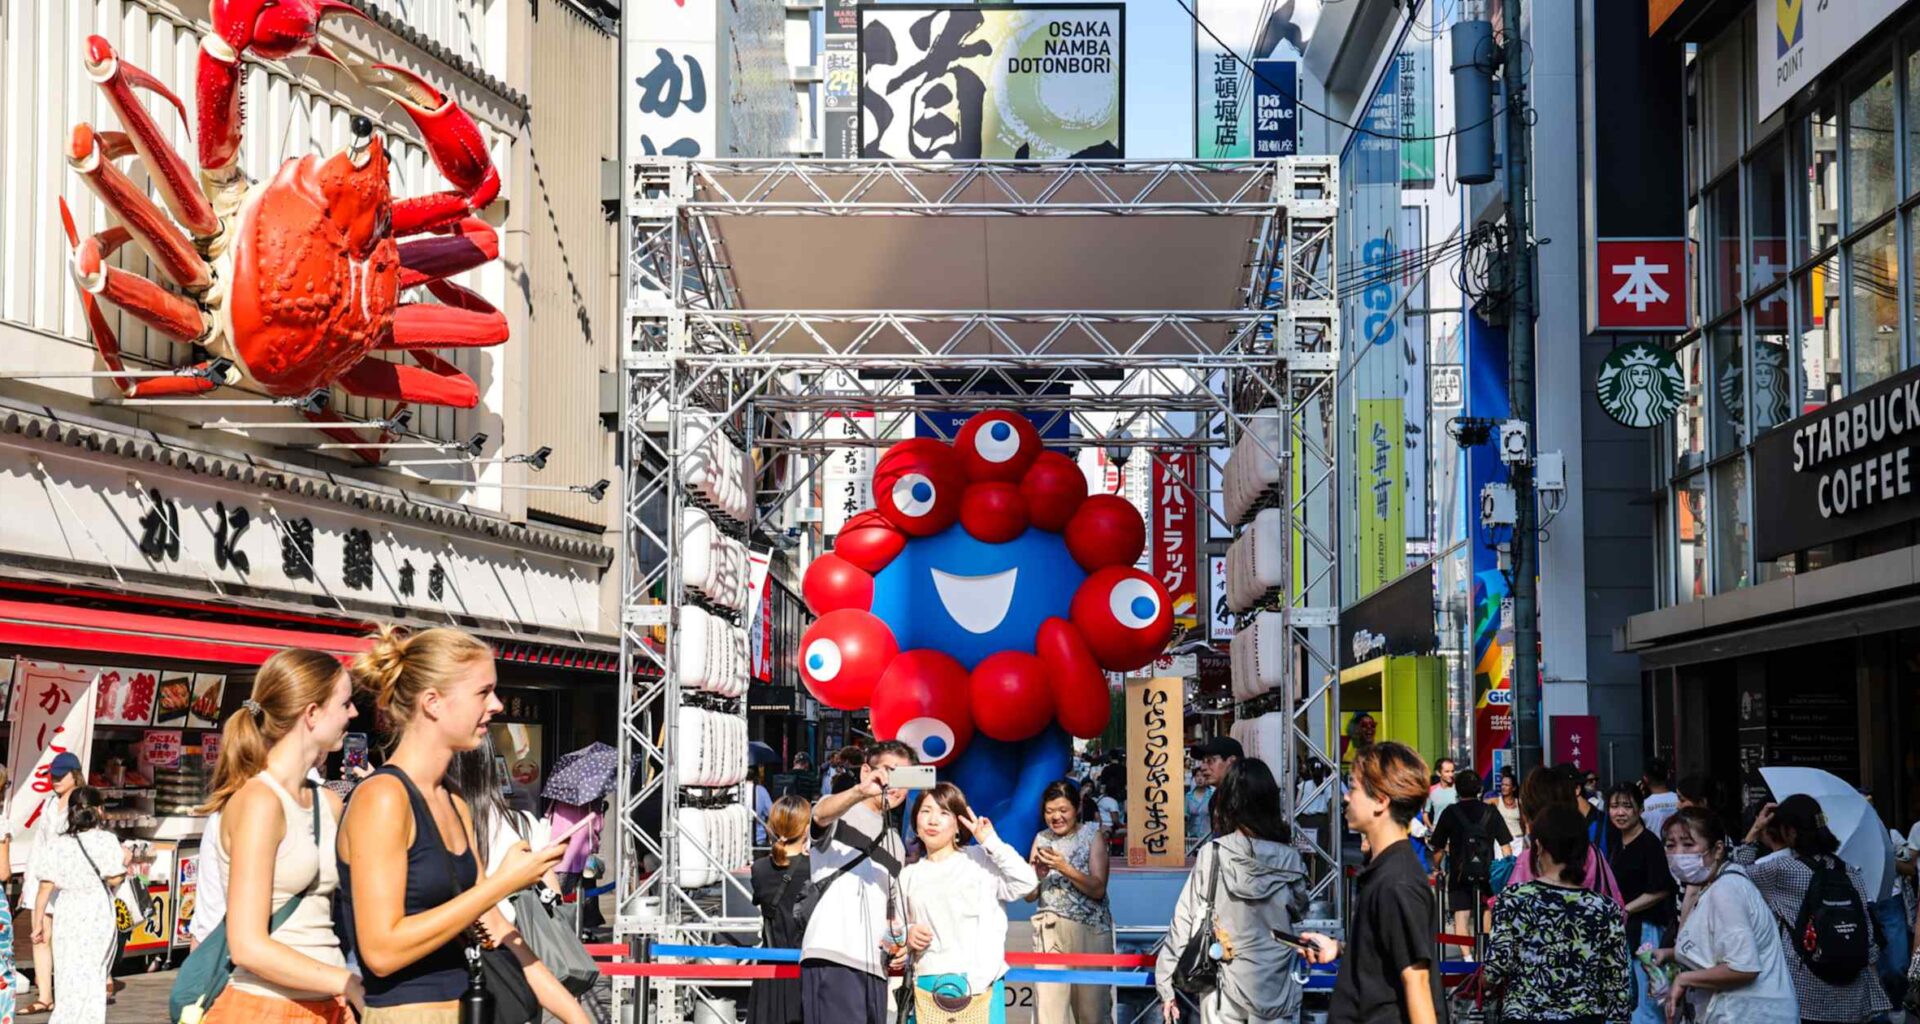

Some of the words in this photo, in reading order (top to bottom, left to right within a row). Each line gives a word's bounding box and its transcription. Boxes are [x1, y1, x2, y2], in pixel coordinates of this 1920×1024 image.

[1049, 21, 1111, 38] OSAKA
[1044, 39, 1111, 56] NAMBA
[1008, 56, 1111, 75] DOTONBORI
[1777, 47, 1804, 88] POINT
[1214, 52, 1238, 147] 道頓堀店
[1258, 118, 1279, 131] Za
[1612, 256, 1670, 313] 本
[1816, 446, 1912, 520] COFFEE
